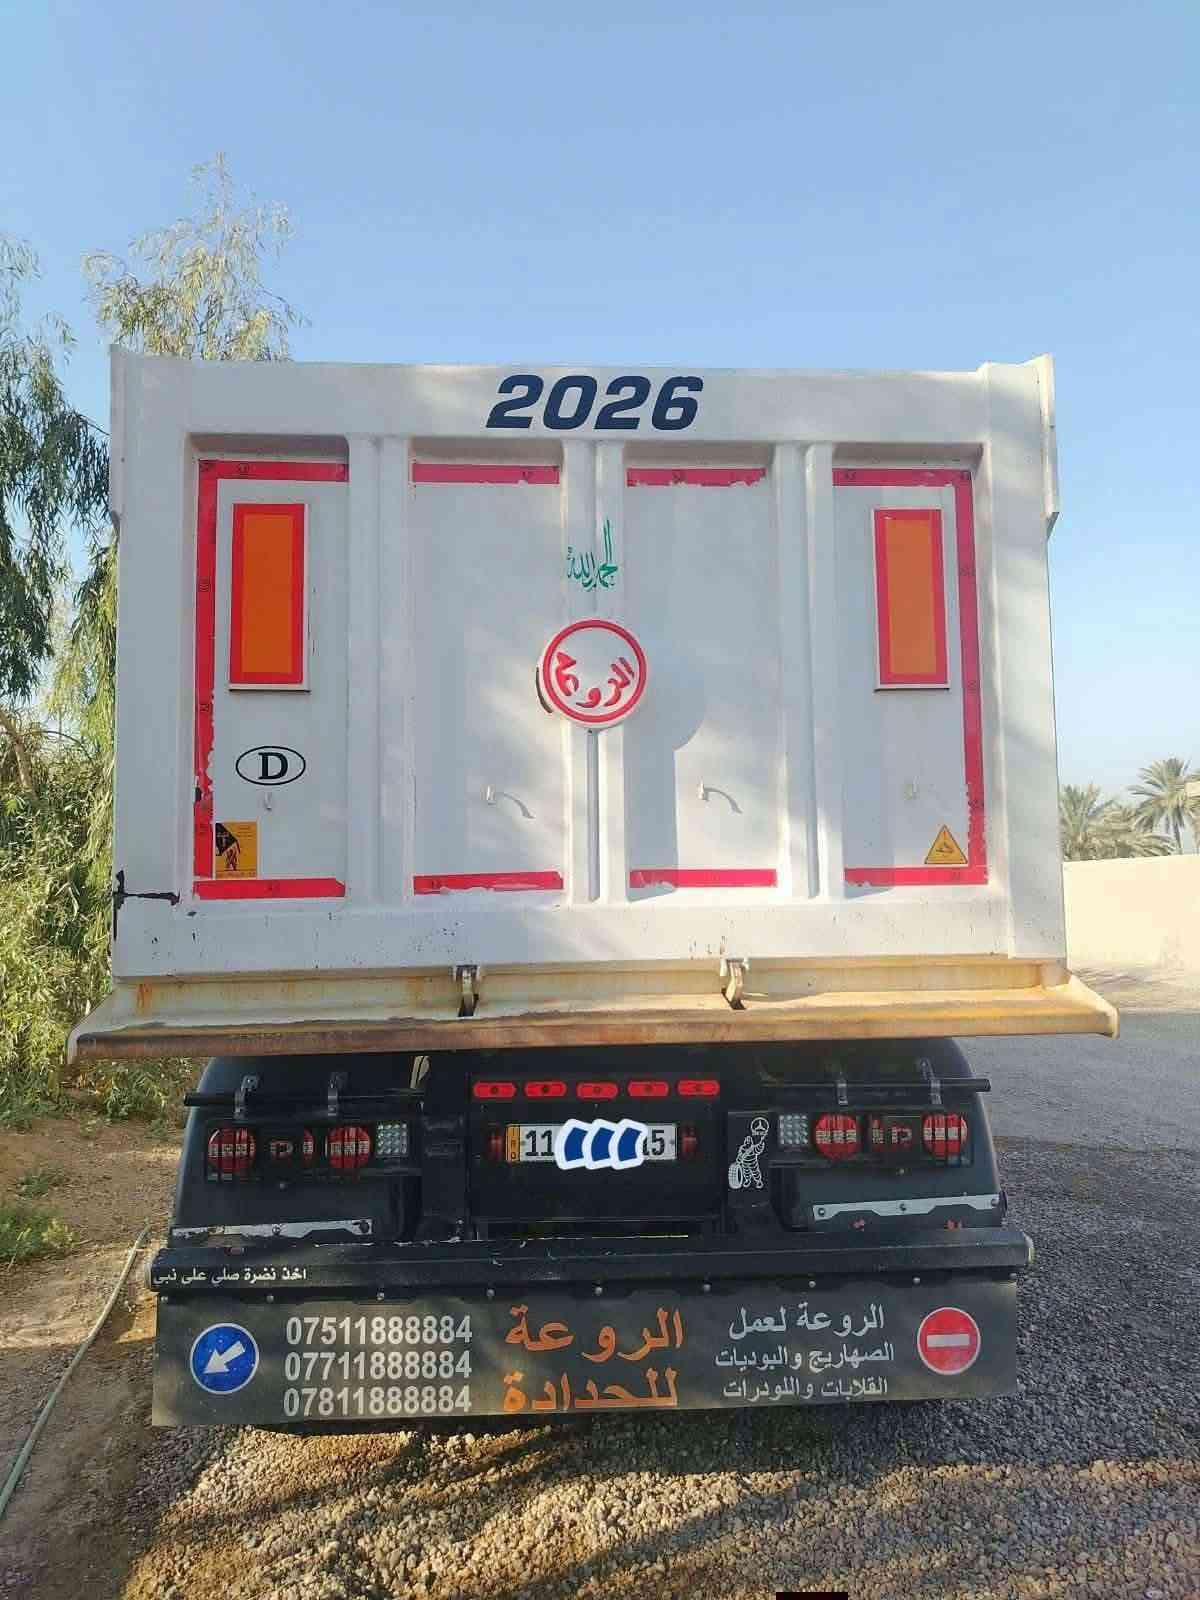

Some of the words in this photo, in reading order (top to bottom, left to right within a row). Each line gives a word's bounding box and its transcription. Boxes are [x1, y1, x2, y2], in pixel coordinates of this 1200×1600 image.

[486, 374, 704, 431] 2026
[258, 751, 289, 780] D
[286, 1314, 473, 1346] 07511888884
[505, 1304, 684, 1363] الروعة
[729, 1306, 787, 1340] لعمل
[796, 1302, 885, 1337] الروعة
[284, 1350, 473, 1381] 07711888884
[808, 1341, 895, 1373] الصهاريج
[283, 1384, 472, 1417] 07811888884
[503, 1367, 678, 1412] للحدادة
[820, 1376, 888, 1400] القلابات
